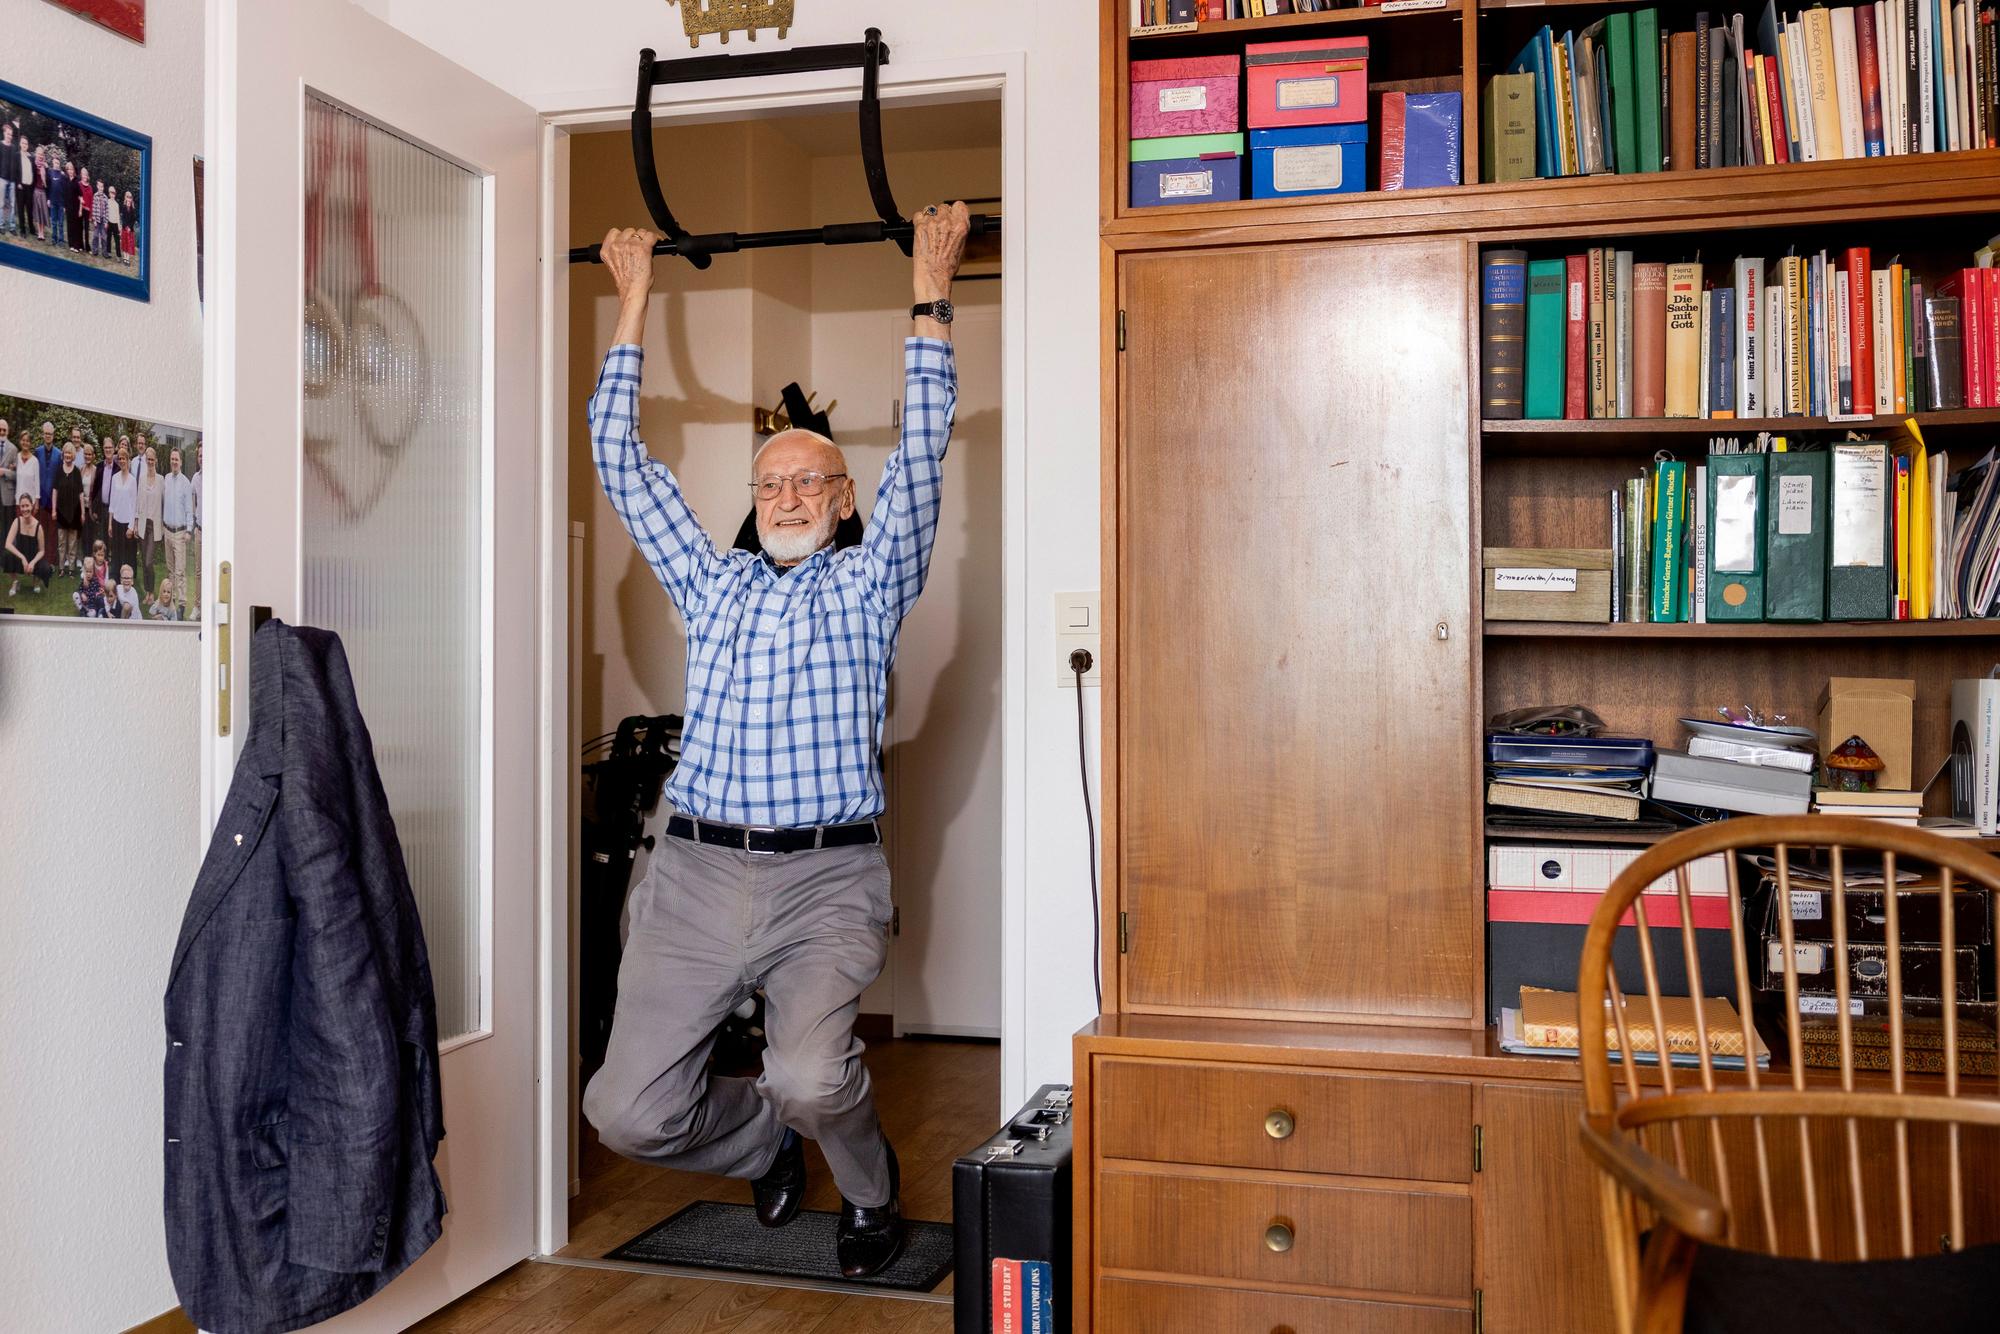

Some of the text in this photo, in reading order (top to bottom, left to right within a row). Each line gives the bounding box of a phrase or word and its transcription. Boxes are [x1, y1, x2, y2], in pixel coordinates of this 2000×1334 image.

[1699, 20, 1708, 67] GEGENWART
[1700, 69, 1708, 105] DEUTSCHE
[1711, 59, 1719, 93] GOETHE
[1814, 72, 1824, 80] ist
[1815, 81, 1826, 100] Alles
[1700, 120, 1708, 135] UND
[1700, 136, 1708, 164] OETHE
[1871, 142, 1881, 157] REUZ
[1593, 249, 1601, 302] PREDIGTEN
[1856, 257, 1864, 299] Lutherland
[1667, 304, 1699, 313] Sache
[1674, 295, 1693, 304] Die
[1671, 321, 1694, 329] Gott
[1673, 312, 1692, 320] mit
[1788, 258, 1799, 409] KLEINER BILDATLAS ZUR BIBEL
[1747, 392, 1755, 411] Piper
[1973, 392, 1981, 404] dtv
[1667, 469, 1675, 496] Pötschke
[1665, 496, 1673, 520] Gärtner
[1663, 531, 1673, 581] Garten-Ratgeber
[1697, 525, 1705, 604] DER STADT BESTES
[1662, 580, 1671, 615] Praktischer
[1003, 1265, 1011, 1309] STUDENT
[1031, 1267, 1040, 1286] LINES
[1031, 1286, 1041, 1311] EXPORT
